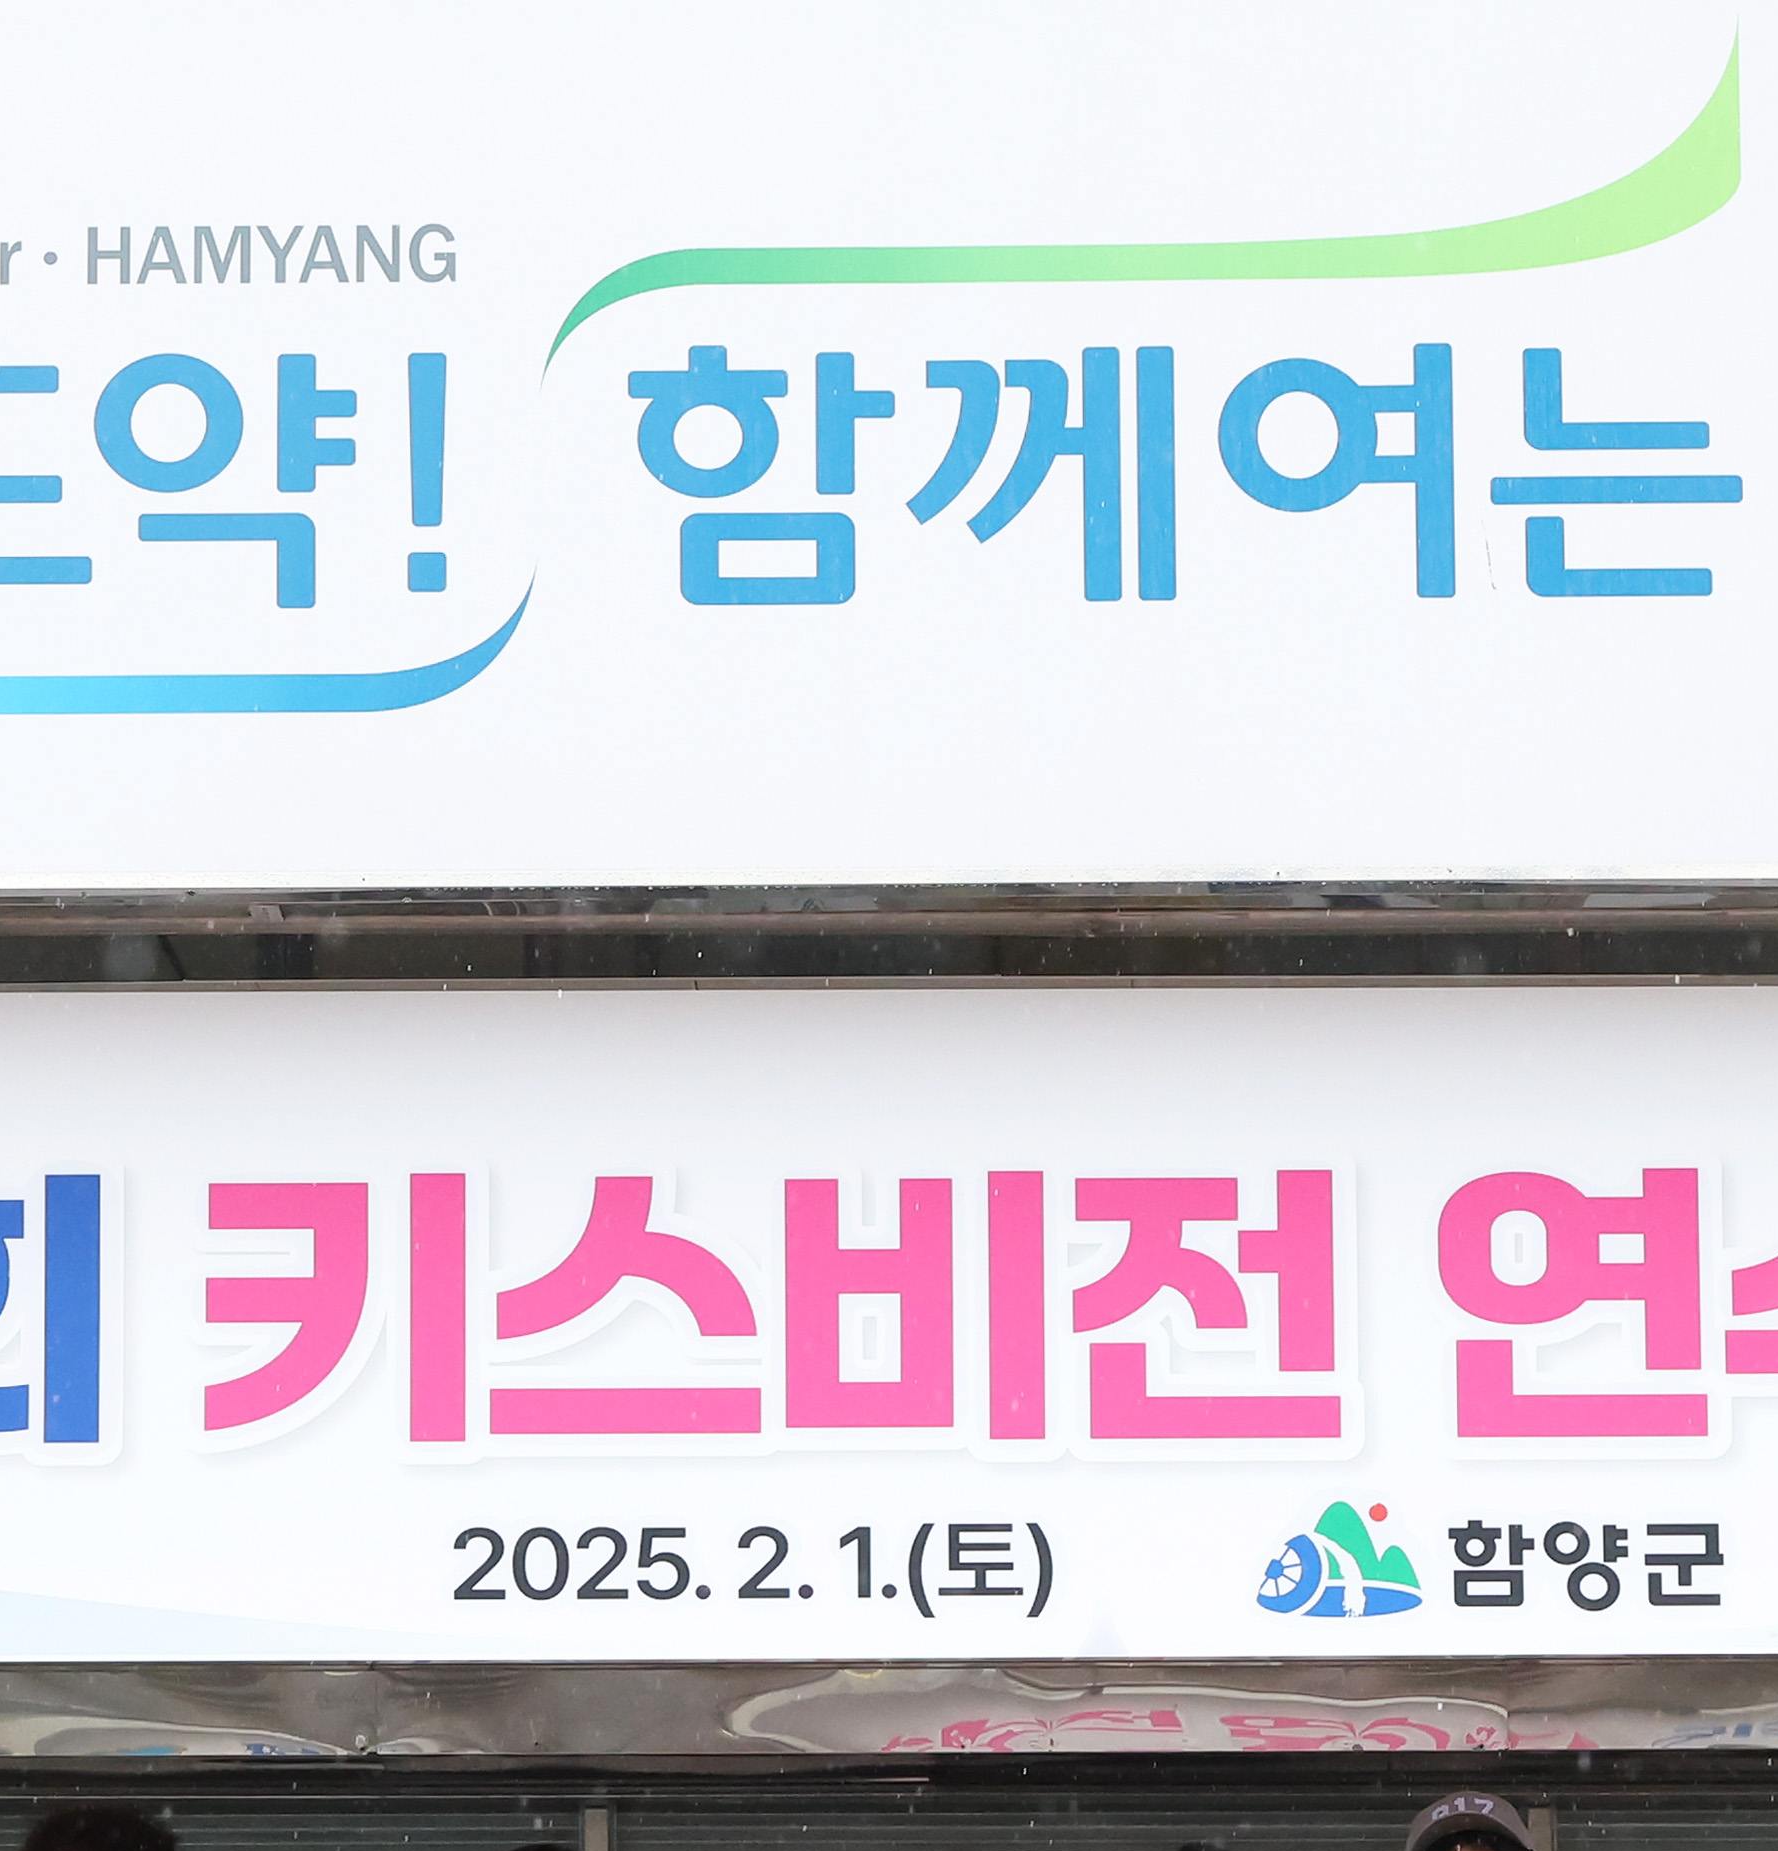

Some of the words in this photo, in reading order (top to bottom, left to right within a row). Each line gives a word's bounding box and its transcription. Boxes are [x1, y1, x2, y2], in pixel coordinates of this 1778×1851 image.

[85, 222, 458, 286] HAMYANG
[627, 344, 1178, 607] 함께
[1217, 341, 1744, 599] 여는
[203, 1168, 1342, 1443] 키스비전
[452, 1525, 712, 1602] 2025.
[737, 1524, 815, 1600] 2.
[1447, 1518, 1725, 1613] 함양군
